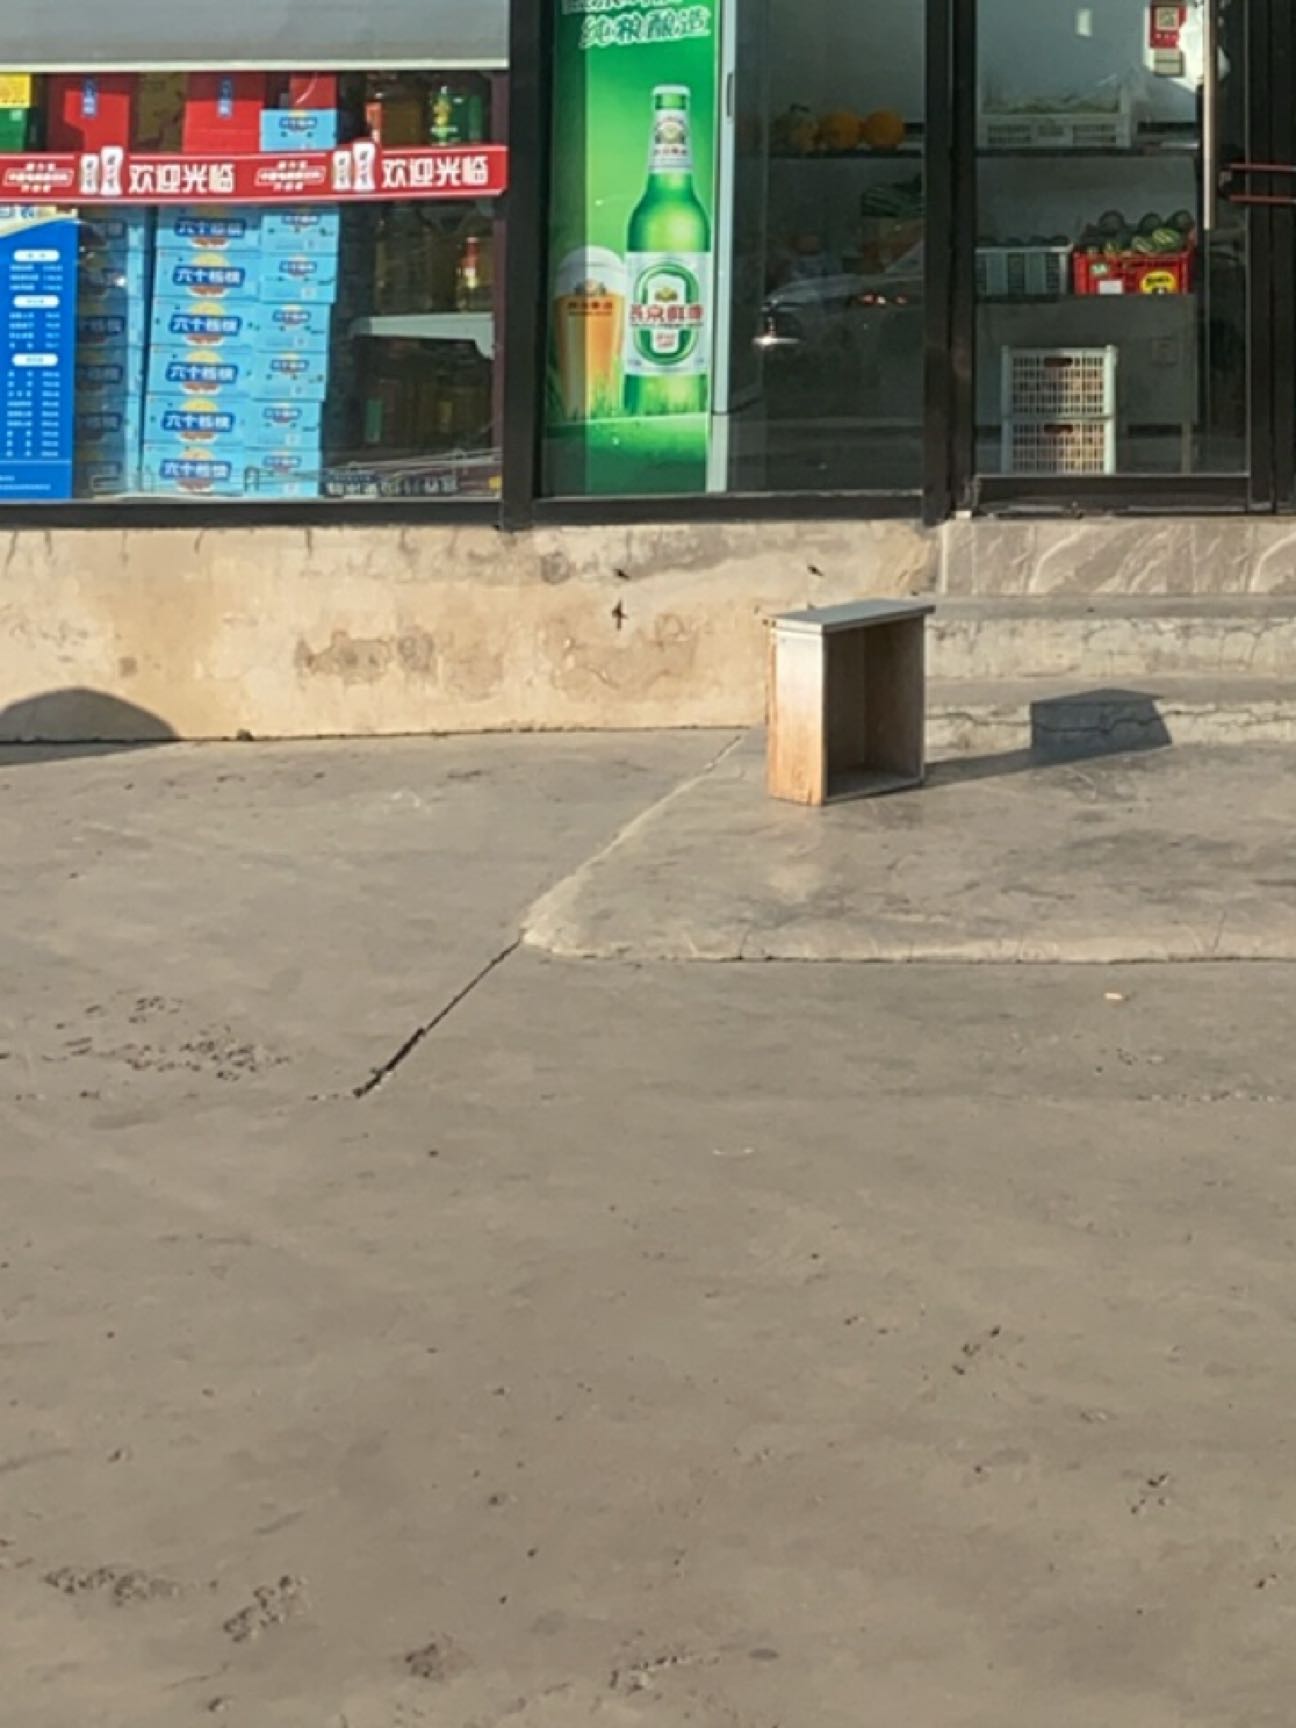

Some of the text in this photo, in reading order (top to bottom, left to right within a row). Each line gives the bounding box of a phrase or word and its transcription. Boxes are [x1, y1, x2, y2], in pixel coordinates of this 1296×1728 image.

[128, 163, 236, 194] 欢迎光临
[381, 156, 489, 189] 欢迎光临
